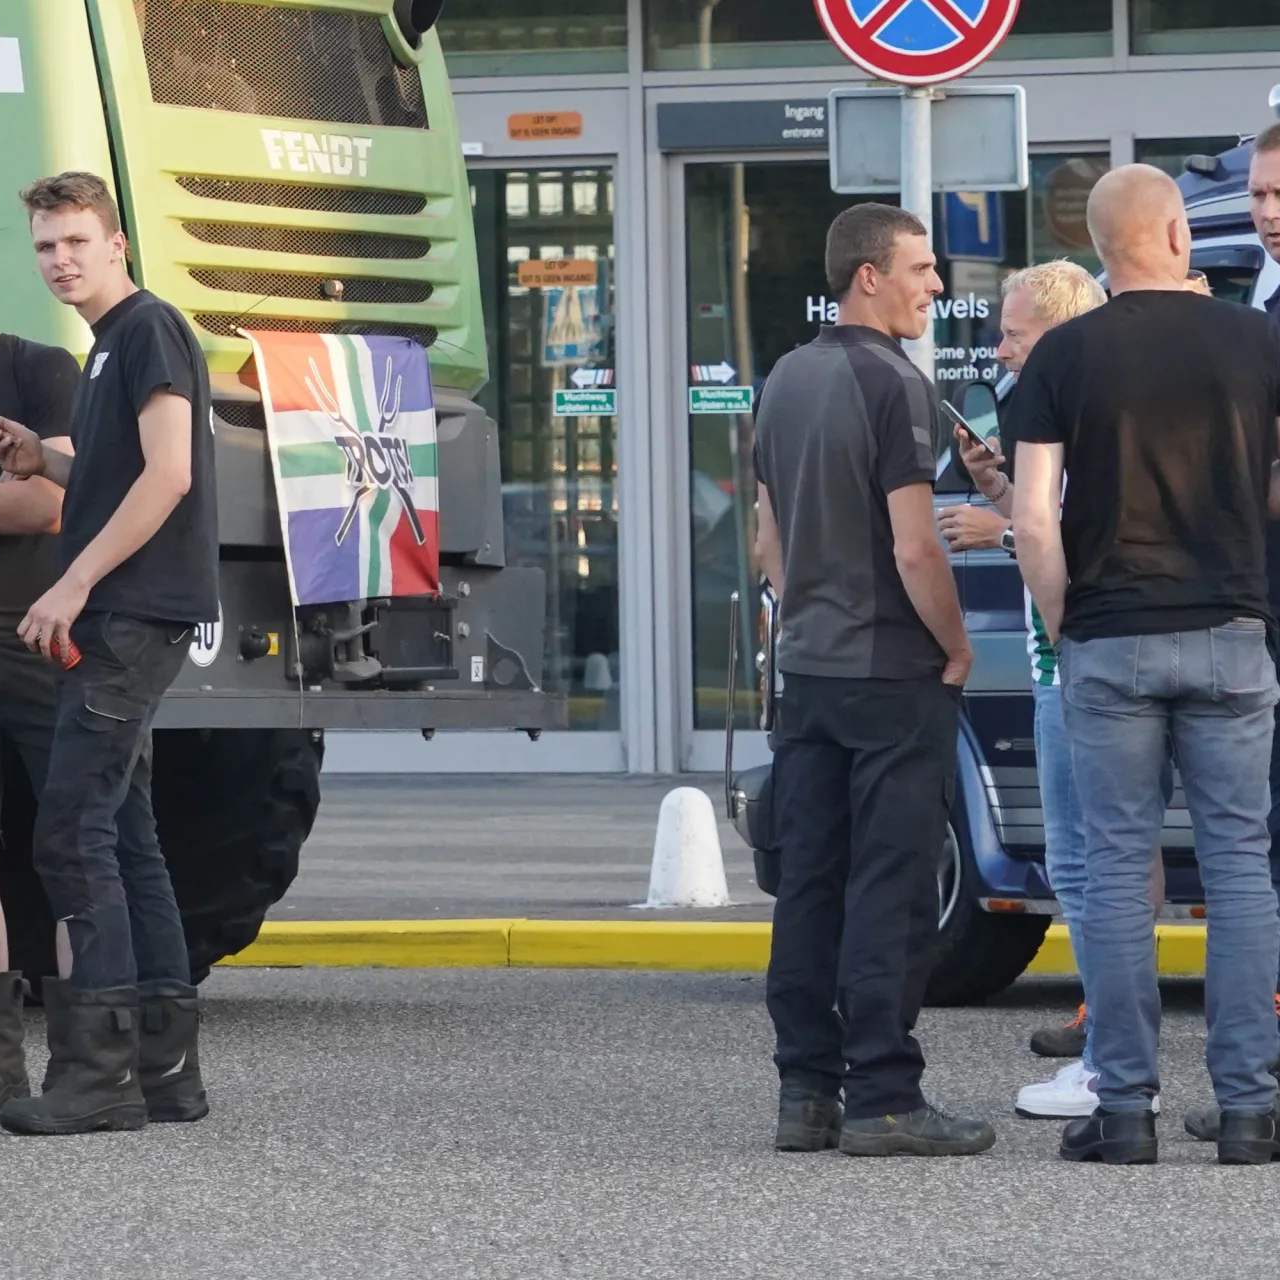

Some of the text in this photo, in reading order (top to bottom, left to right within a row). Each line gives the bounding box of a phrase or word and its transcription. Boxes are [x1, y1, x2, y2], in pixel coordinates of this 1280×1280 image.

[784, 104, 824, 121] Ingang
[782, 128, 824, 138] entrance
[260, 128, 373, 177] FENDT
[937, 362, 999, 380] north of
